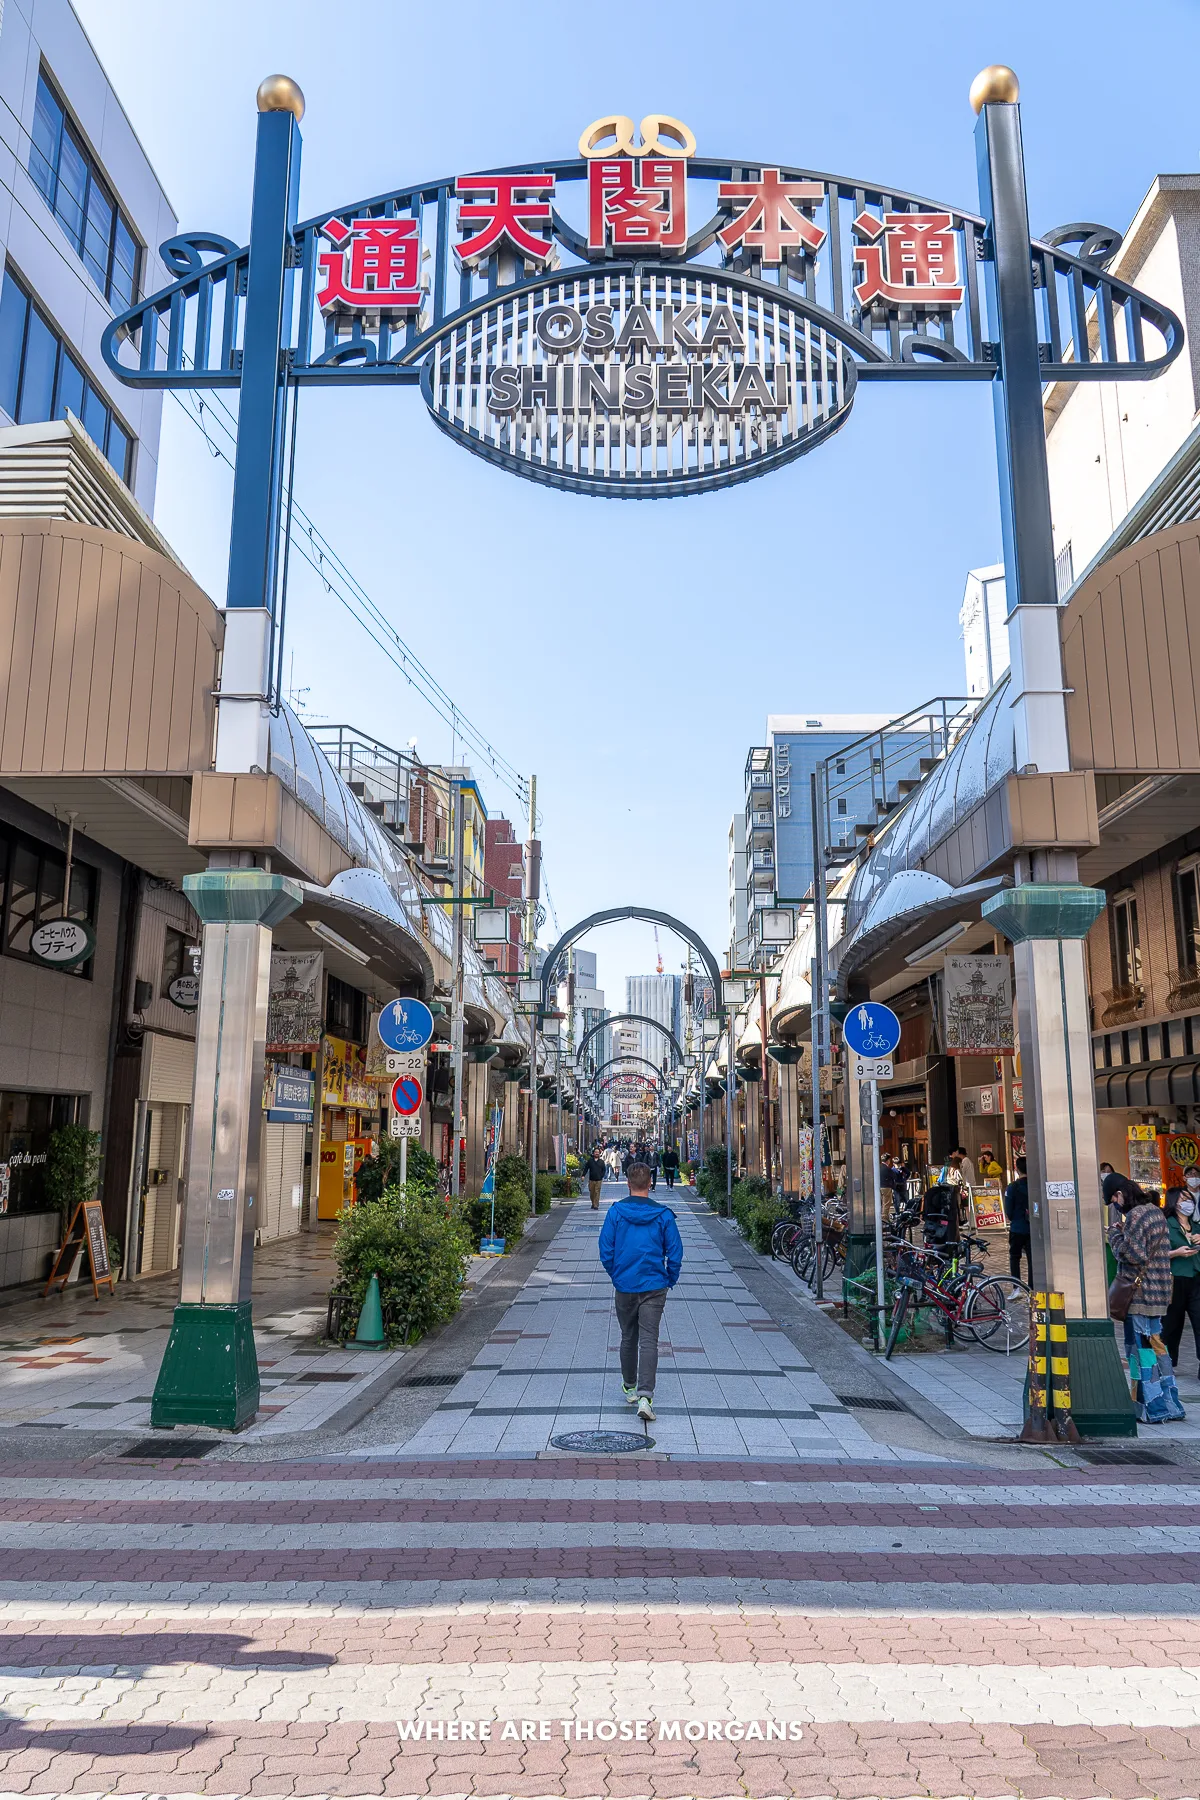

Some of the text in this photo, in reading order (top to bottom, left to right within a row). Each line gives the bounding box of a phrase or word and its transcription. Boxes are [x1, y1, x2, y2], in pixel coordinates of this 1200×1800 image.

[316, 158, 966, 309] 通天閣本通
[536, 304, 745, 353] OSAKA
[488, 364, 791, 413] SHINSEKAI
[40, 927, 76, 939] コーヒーハウス
[392, 1127, 420, 1136] ここから
[978, 1214, 1003, 1226] OPEN!
